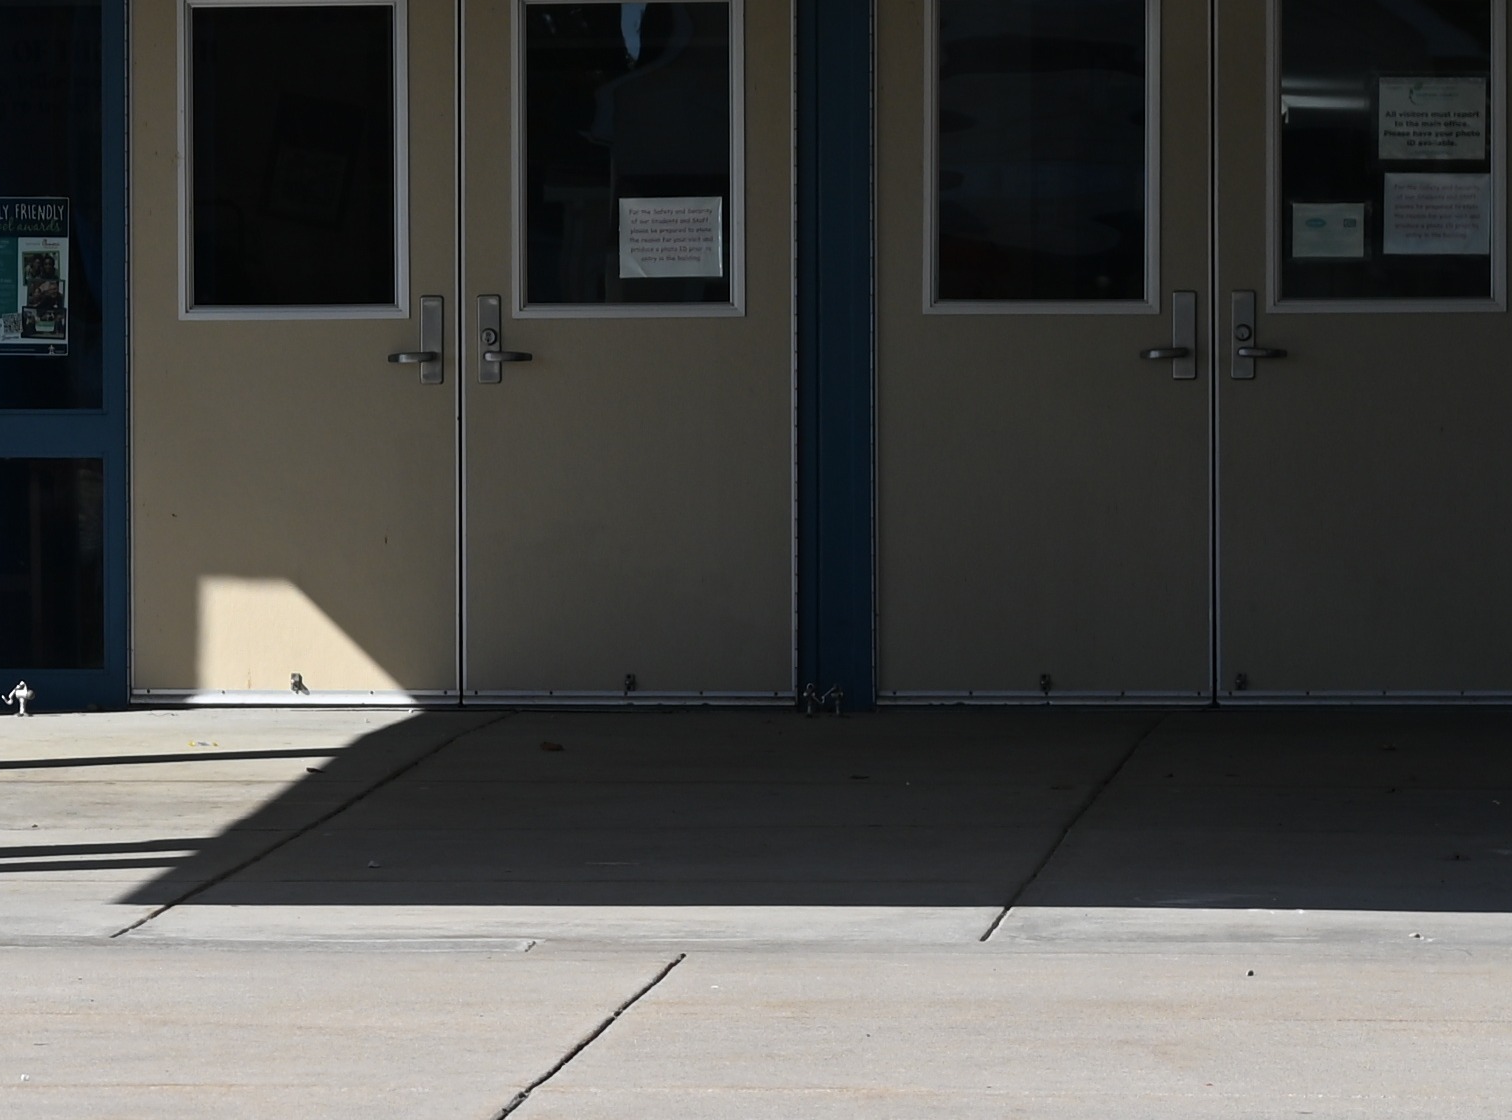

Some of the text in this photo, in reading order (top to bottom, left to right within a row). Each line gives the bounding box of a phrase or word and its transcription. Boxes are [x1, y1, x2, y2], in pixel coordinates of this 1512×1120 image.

[1385, 110, 1479, 119] All visitors must report
[1456, 130, 1480, 138] photo
[15, 203, 64, 221] FRIENDLY
[16, 218, 62, 232] awards
